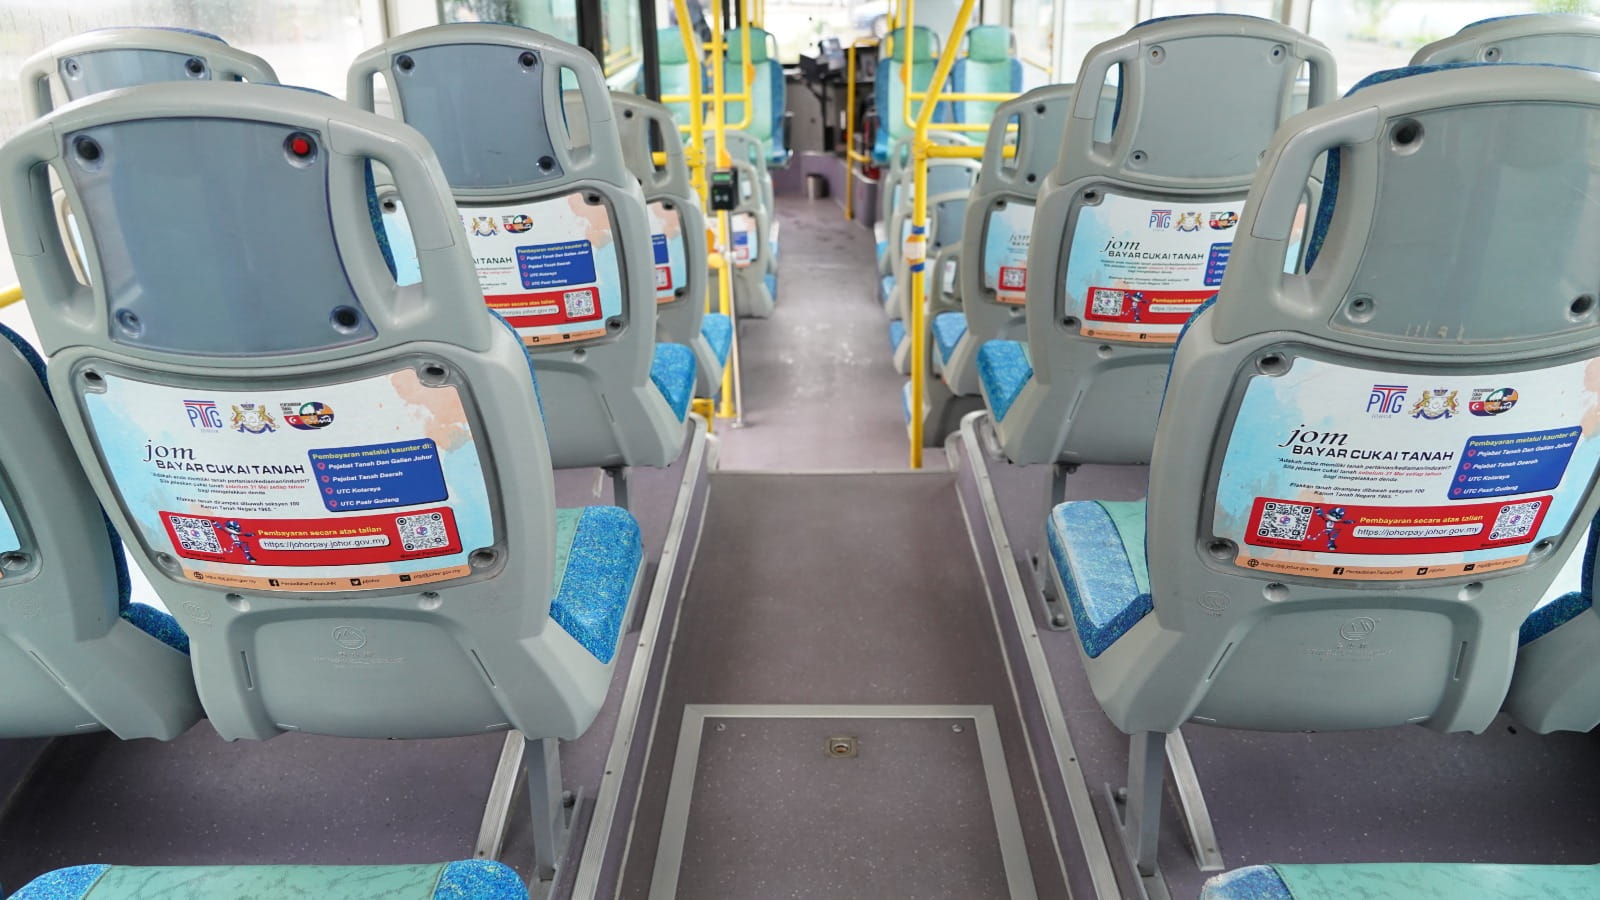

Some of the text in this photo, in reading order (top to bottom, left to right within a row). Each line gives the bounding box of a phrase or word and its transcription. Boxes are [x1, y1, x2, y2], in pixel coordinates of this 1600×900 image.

[1100, 236, 1141, 253] jom
[1108, 250, 1141, 258] BAYAR
[1142, 252, 1171, 260] CUKAI
[1366, 384, 1409, 413] PTG
[183, 400, 223, 428] PTG
[1278, 423, 1349, 448] jom
[1469, 439, 1515, 447] Pembayaran
[1515, 436, 1541, 444] melalui
[1542, 433, 1568, 441] kaunter
[143, 439, 197, 461] jom
[312, 451, 360, 460] Pembayaran
[362, 448, 389, 457] melalui
[391, 444, 420, 454] kaunter
[1292, 444, 1454, 461] BAYAR CUKAI TANAH
[1477, 449, 1502, 457] Pejabat
[155, 460, 305, 474] BAYAR CUKAI TANAH
[328, 461, 354, 470] Pejabat
[355, 460, 375, 468] Tanah
[391, 456, 412, 464] Galian
[413, 454, 433, 462] Johor
[1472, 462, 1496, 470] Pejabat
[1516, 459, 1538, 467] Daerah
[332, 475, 357, 483] Pejabat
[352, 486, 381, 494] Kotaraya
[1495, 485, 1519, 493] Gudang
[374, 496, 400, 505] Gudang
[1359, 517, 1412, 526] Pembayaran
[257, 529, 308, 538] Pembayaran
[1357, 526, 1480, 537] https://johorpay.johor.gov.my
[263, 537, 386, 549] https://johorpay.johor.gov.my
